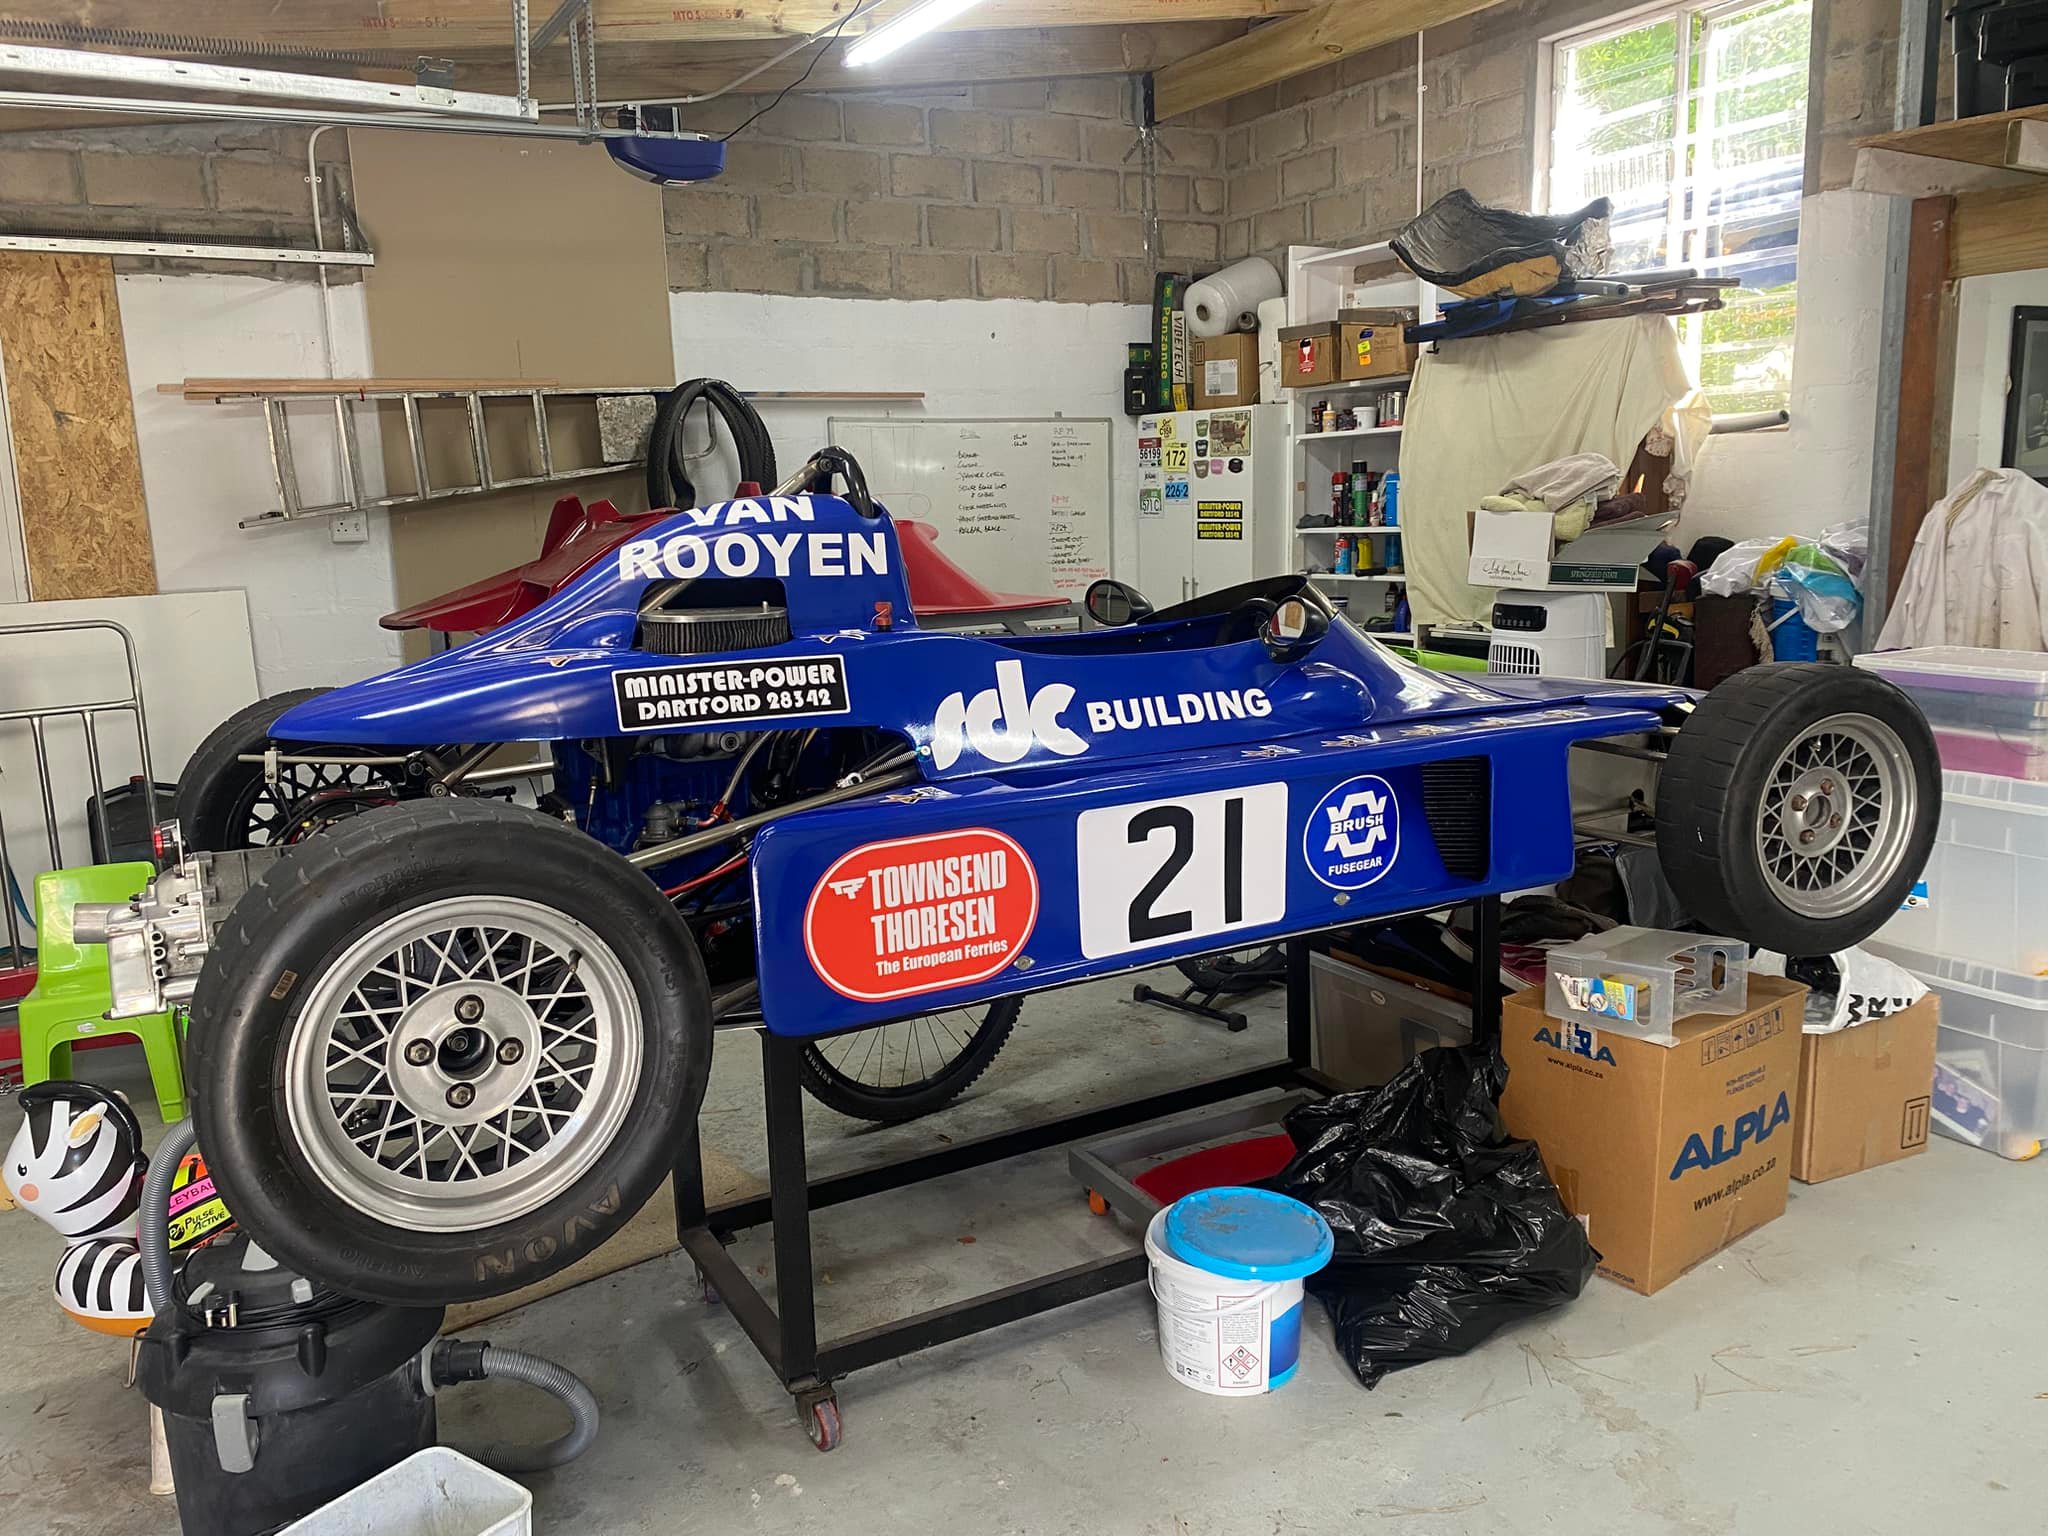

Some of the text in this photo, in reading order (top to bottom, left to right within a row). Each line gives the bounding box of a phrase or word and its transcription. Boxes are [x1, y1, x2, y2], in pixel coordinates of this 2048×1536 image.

[1173, 316, 1184, 378] VIBETECH
[1165, 450, 1186, 466] 172
[687, 496, 815, 526] VAN
[1165, 484, 1189, 498] 226-2
[618, 531, 888, 581] ROOYEN
[624, 664, 837, 699] MINISTER-POWER
[638, 688, 832, 721] DARTFORD 28342
[1086, 688, 1273, 734] BUILDING
[1330, 814, 1384, 835] BRUSH
[868, 850, 1007, 910] TOWNSEND
[1127, 797, 1244, 944] 21
[1328, 856, 1383, 877] FUSEGEAR
[871, 895, 996, 956] THORESEN
[876, 939, 1009, 977] The European Ferries
[1533, 1027, 1617, 1067] ALA
[1547, 1057, 1604, 1080] www.alpla.co.za
[1669, 1090, 1790, 1180] ALPLA
[1694, 1157, 1777, 1211] www.alpla.co.za
[473, 1178, 622, 1282] AVON
